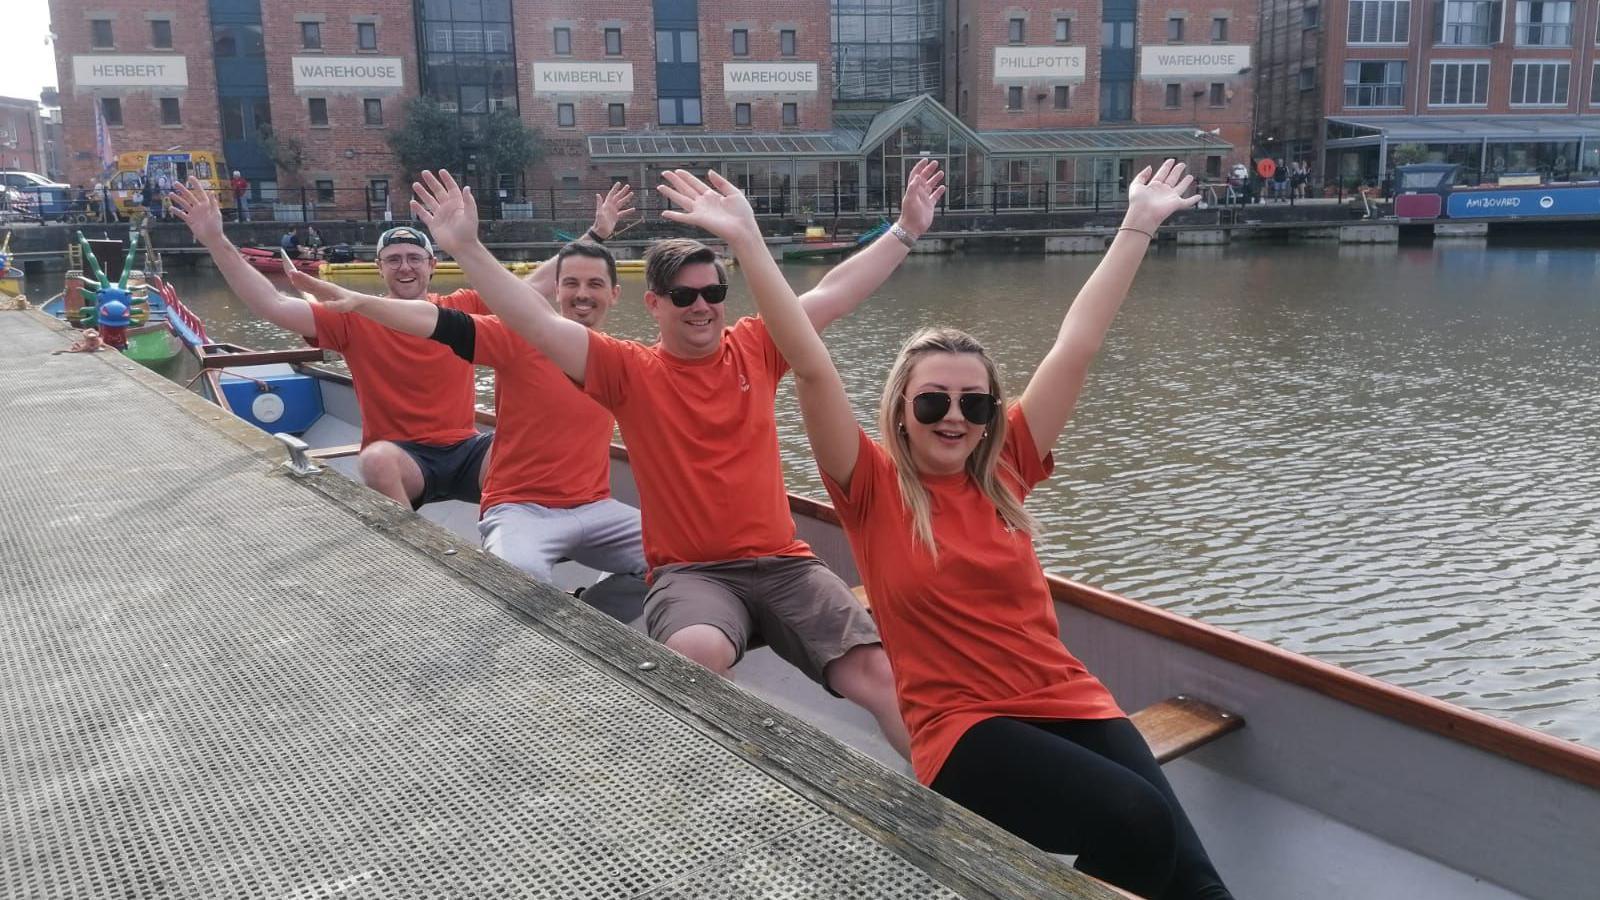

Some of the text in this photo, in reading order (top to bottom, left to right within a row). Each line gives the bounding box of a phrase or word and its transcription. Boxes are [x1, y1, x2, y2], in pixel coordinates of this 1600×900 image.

[1001, 55, 1080, 68] PHILLPOTTS
[1158, 54, 1235, 67] WAREHOUSE
[92, 64, 166, 78] HERBERT
[300, 65, 396, 79] WAREHOUSE
[543, 70, 625, 83] KIMBERLEY
[730, 70, 813, 83] WAREHOUSE
